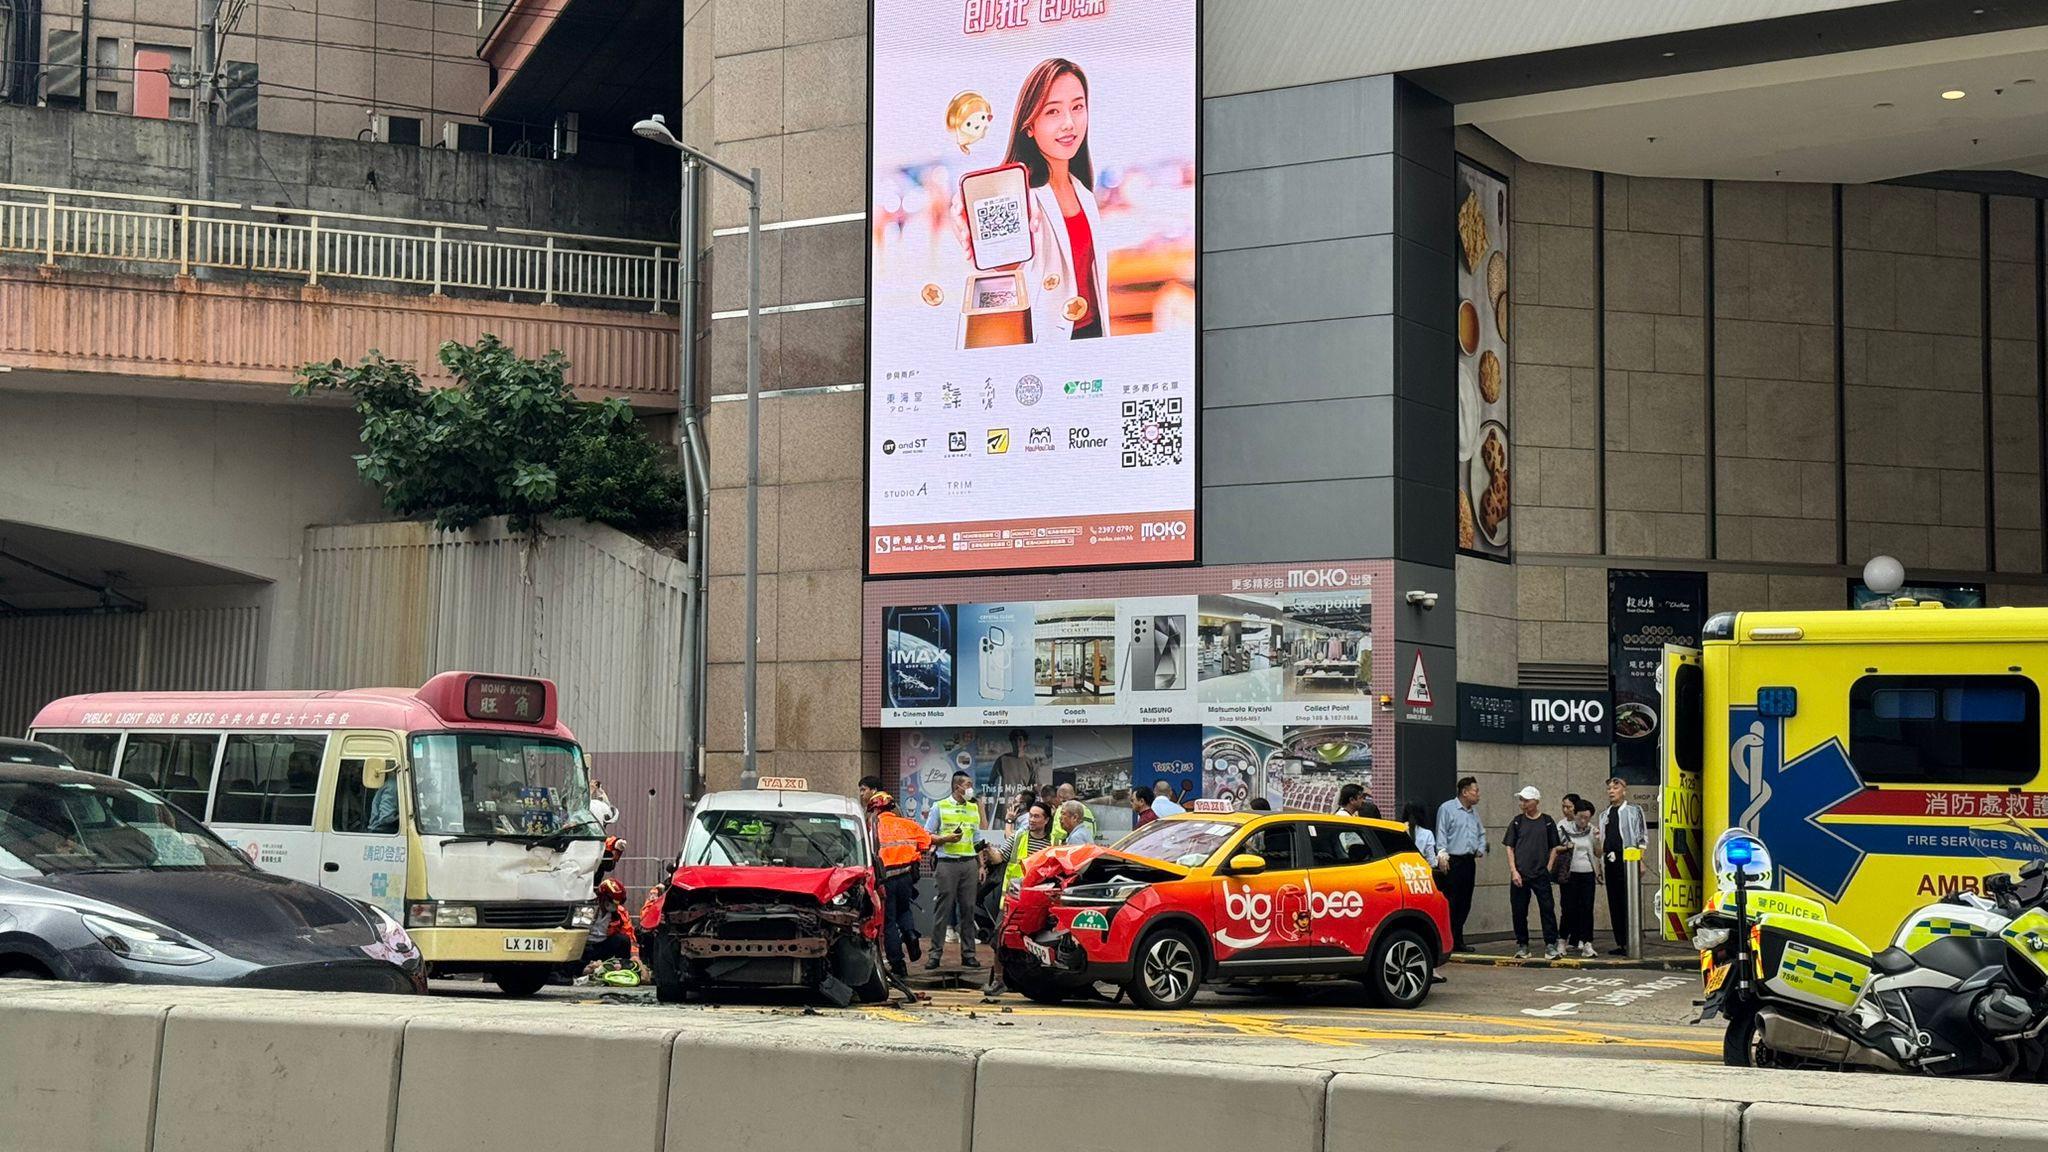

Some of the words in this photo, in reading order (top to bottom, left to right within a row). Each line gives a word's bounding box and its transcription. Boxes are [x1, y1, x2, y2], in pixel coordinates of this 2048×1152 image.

[1080, 379, 1103, 393] 中原
[915, 438, 928, 448] ST
[1069, 438, 1108, 449] Runner
[884, 490, 915, 498] STUDIO
[917, 482, 928, 496] A
[947, 481, 972, 489] TRIM
[1141, 521, 1187, 537] MOKO
[1231, 578, 1284, 590] 更多精彩由
[1288, 568, 1347, 588] MOKO
[891, 649, 947, 664] IMAX
[480, 683, 506, 694] MONG
[480, 696, 530, 717] 旺角
[1064, 708, 1086, 716] Coach
[1140, 706, 1172, 714] SAMSUNG
[1248, 705, 1272, 714] Kiyoshi
[1304, 704, 1330, 712] Collect
[1531, 699, 1604, 723] MOKO
[81, 712, 111, 724] PUBLIC
[116, 712, 143, 724] LIGHT
[146, 713, 165, 724] BUS
[184, 713, 215, 724] SEATS
[762, 778, 804, 788] TAXI
[1196, 801, 1225, 811] TAXI
[1907, 835, 1938, 846] FIRE
[1941, 836, 2008, 850] SERVICES
[363, 845, 406, 862] 請即登記
[1399, 862, 1430, 880] 的士
[1405, 879, 1434, 894] TAXI
[1222, 880, 1272, 933] big
[1303, 878, 1364, 919] bee
[1769, 899, 1809, 920] POLICE
[1087, 916, 1095, 924] 4
[506, 939, 519, 949] LX
[525, 939, 548, 951] 2181
